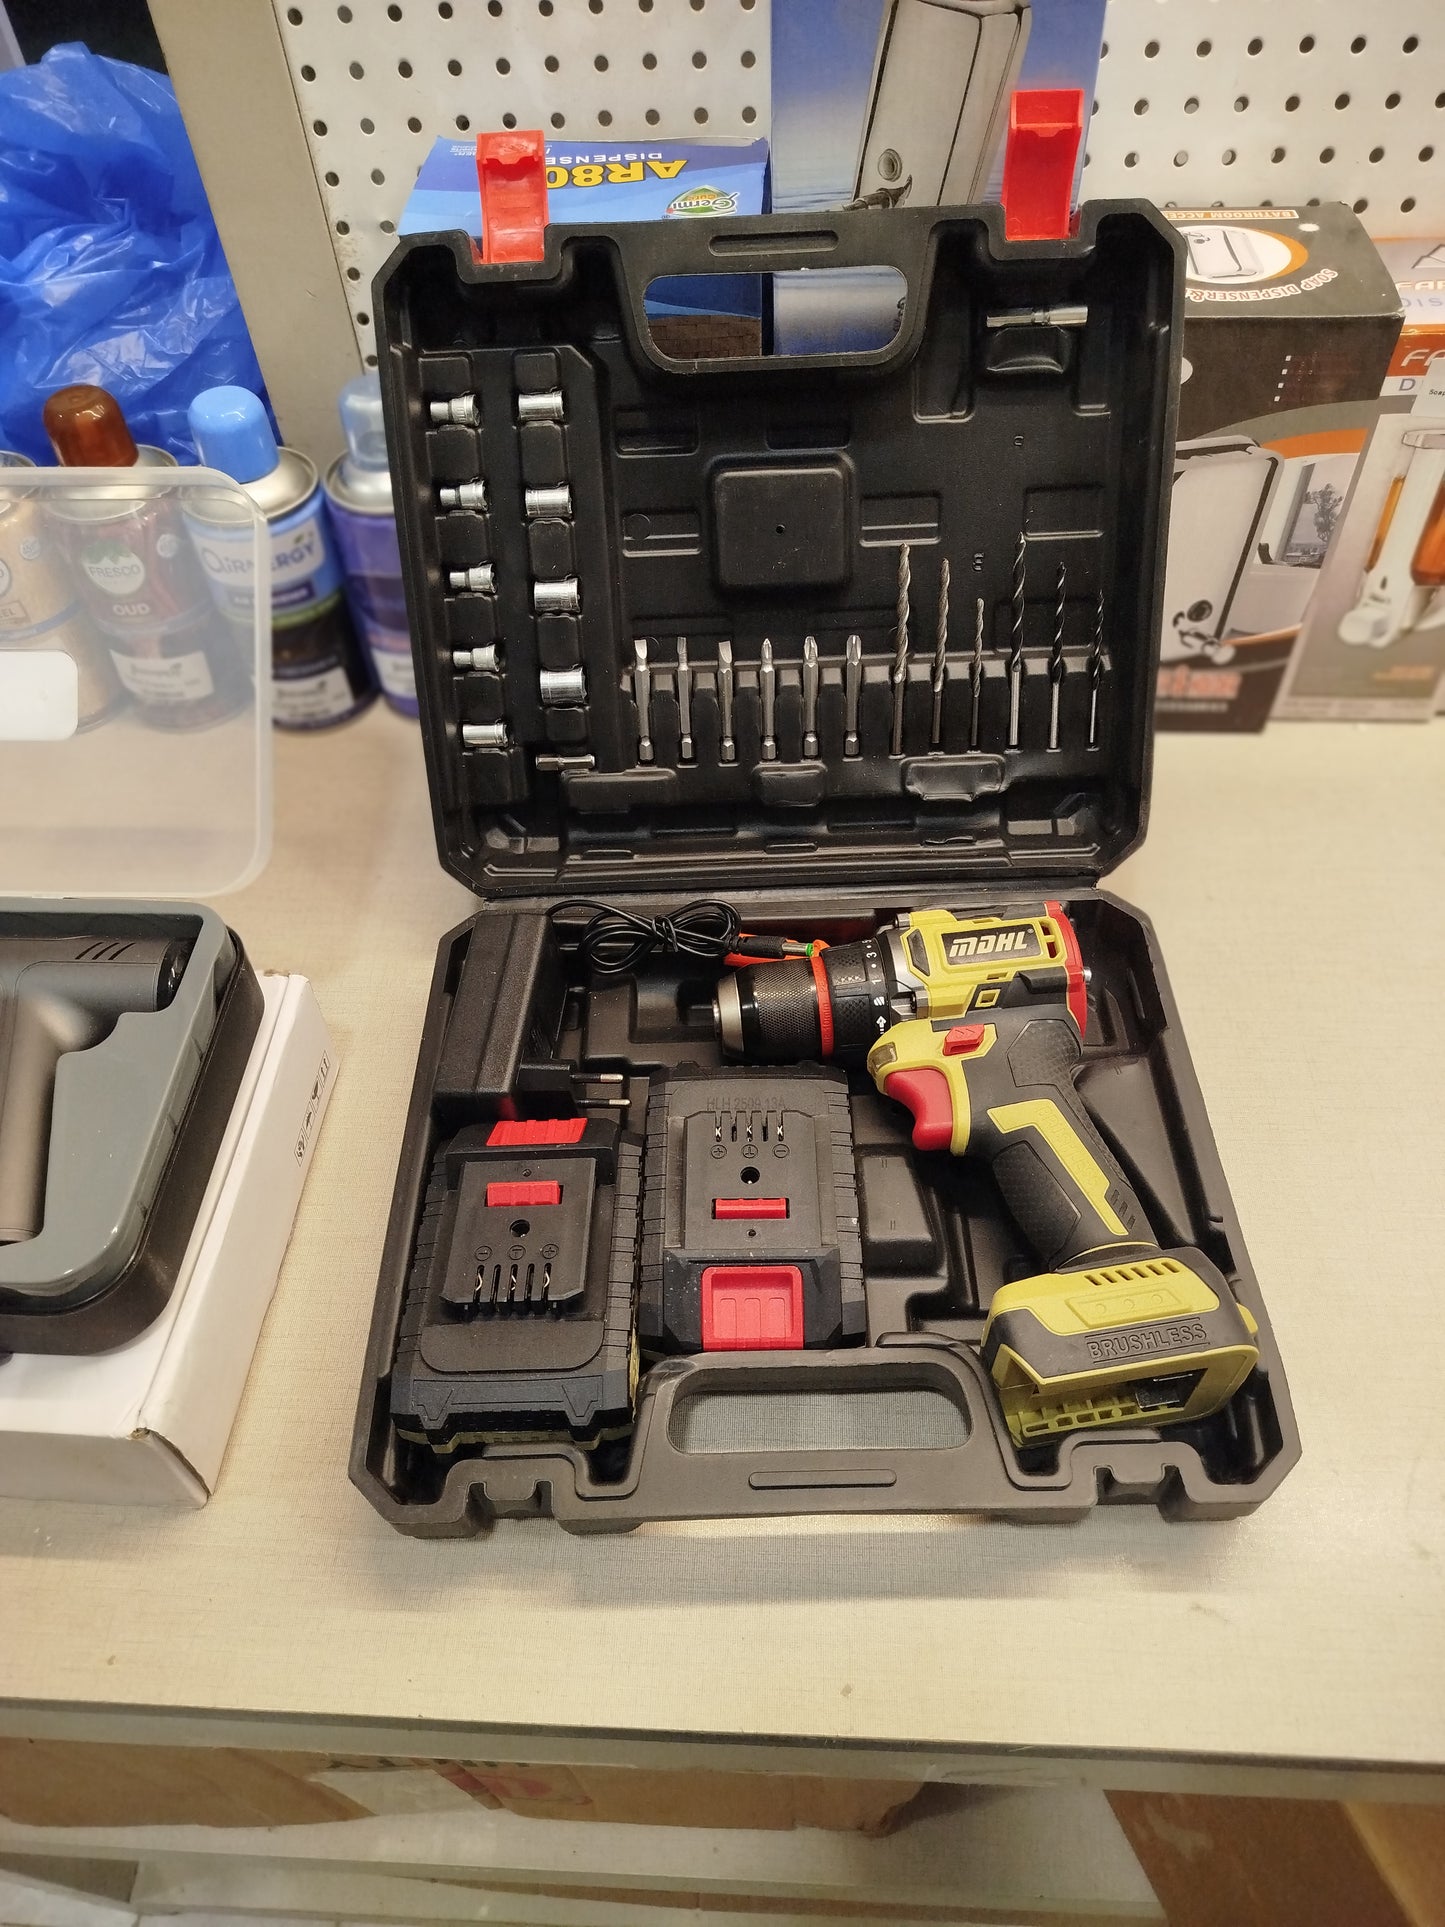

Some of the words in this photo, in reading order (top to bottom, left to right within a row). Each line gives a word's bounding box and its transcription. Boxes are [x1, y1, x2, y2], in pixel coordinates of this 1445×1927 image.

[669, 194, 738, 212] Germi
[1210, 211, 1291, 219] BATHROOM
[1300, 268, 1338, 291] SOAP
[88, 564, 141, 578] FRESCO
[112, 603, 151, 616] OUD
[1086, 1323, 1208, 1359] BRUSHLESS
